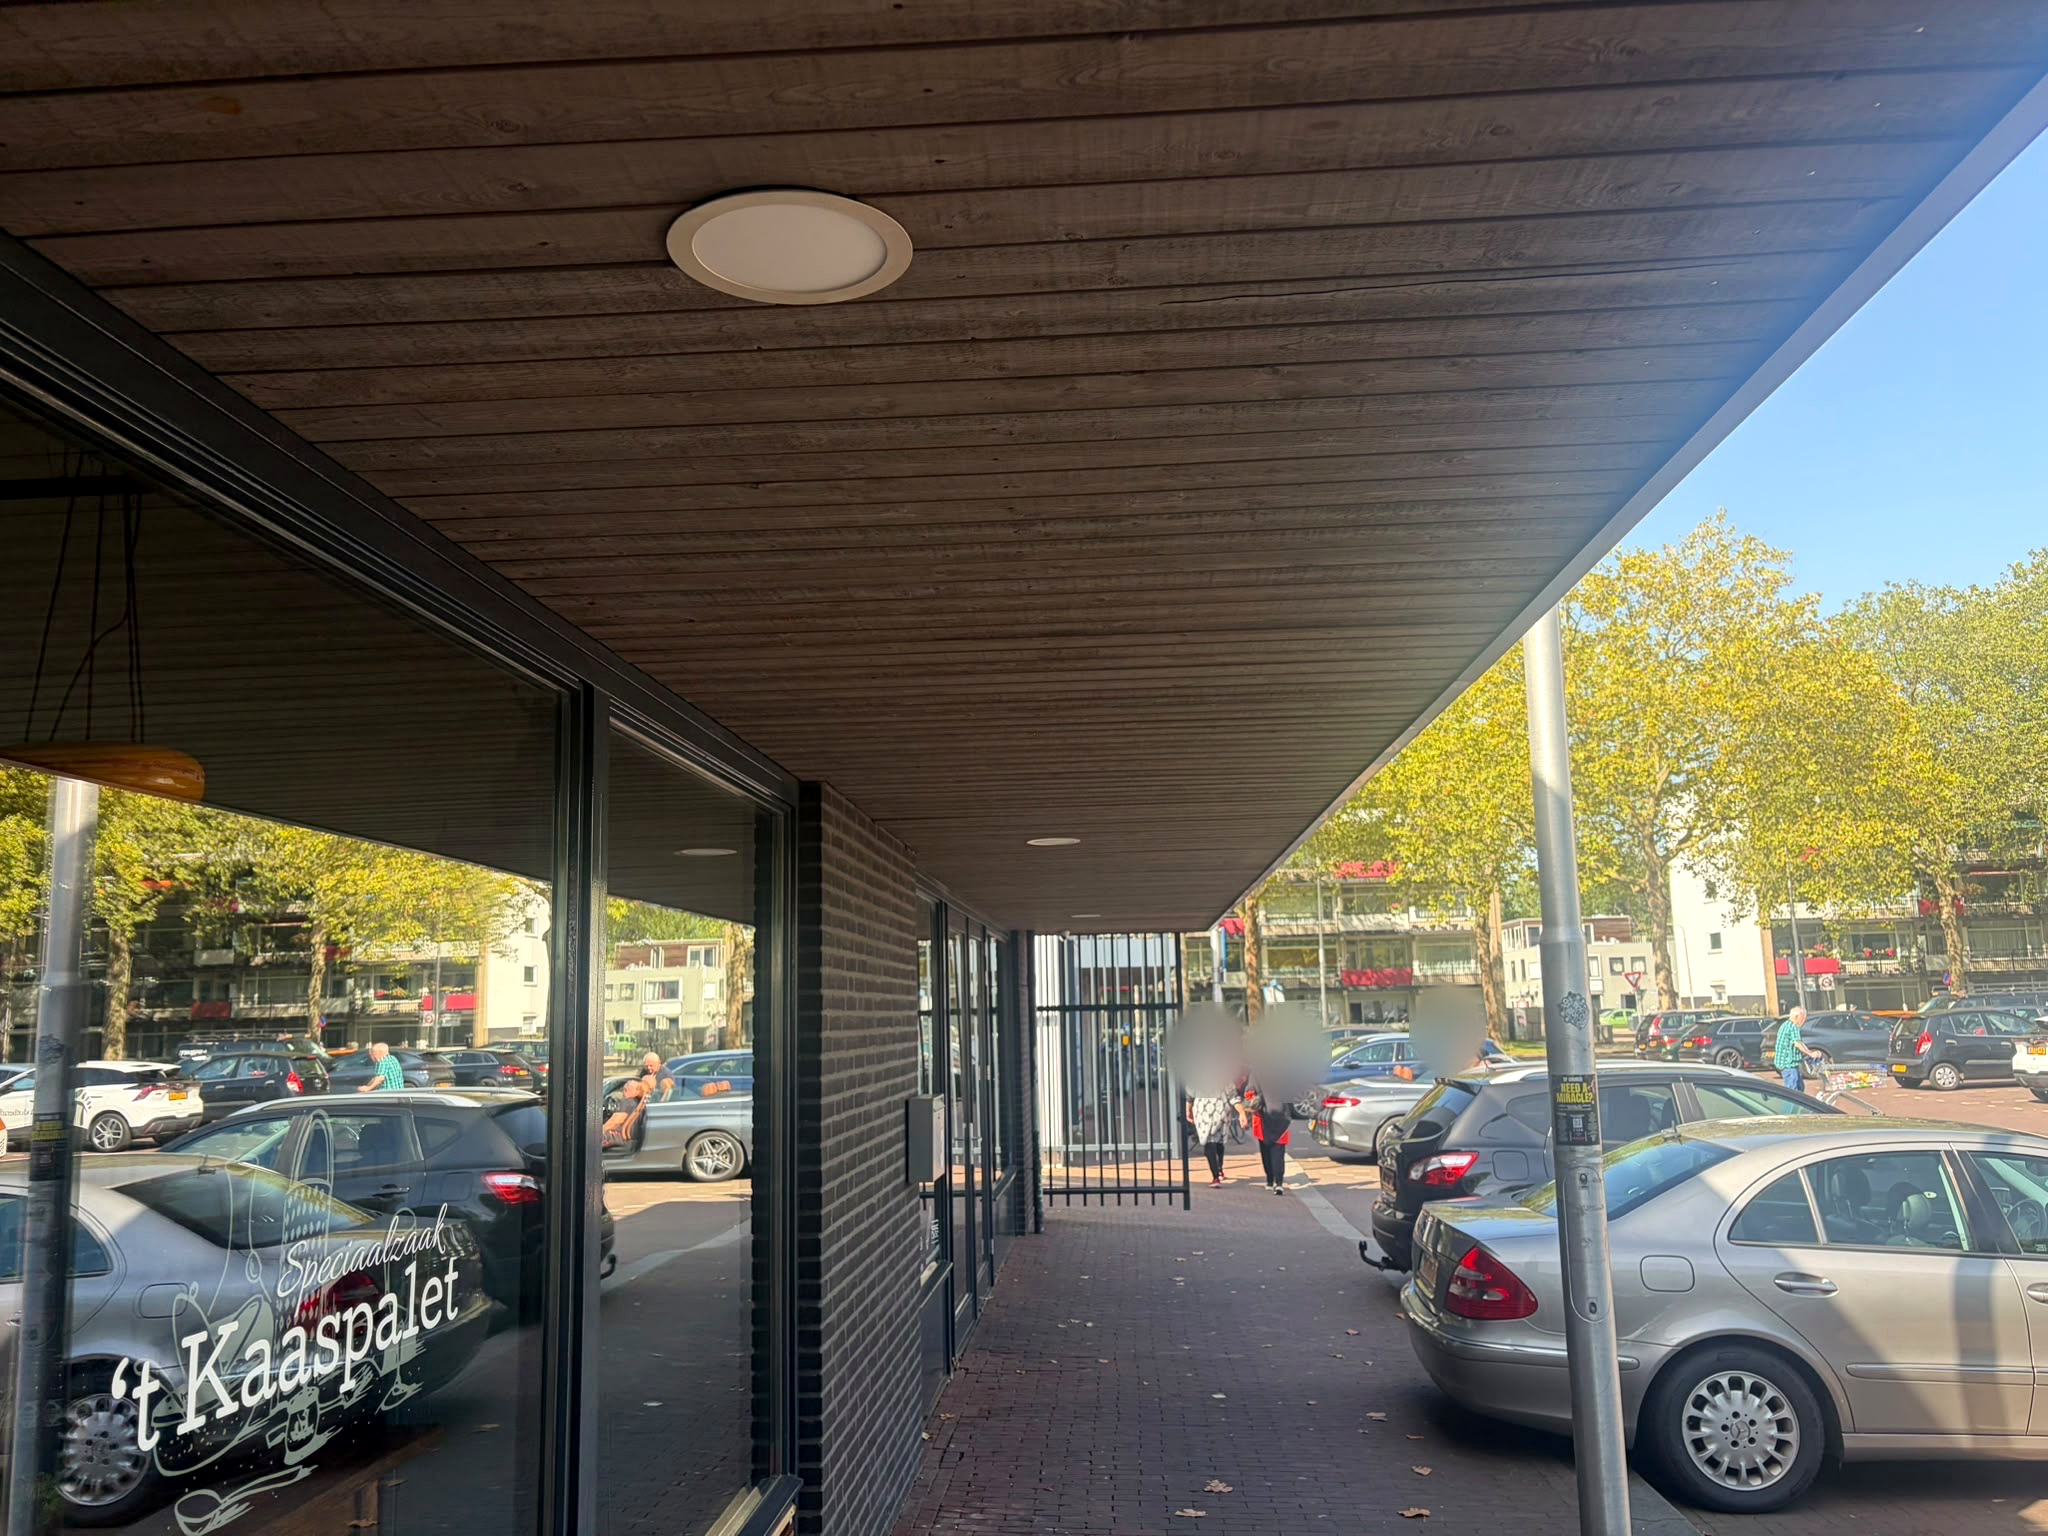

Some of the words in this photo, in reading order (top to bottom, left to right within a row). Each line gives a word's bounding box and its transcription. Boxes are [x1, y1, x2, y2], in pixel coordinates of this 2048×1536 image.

[1556, 1092, 1593, 1104] MIRACLE?
[1560, 1083, 1581, 1093] NEED
[277, 1202, 448, 1318] Speciaalzaak
[176, 1255, 459, 1436] Kaaspalet
